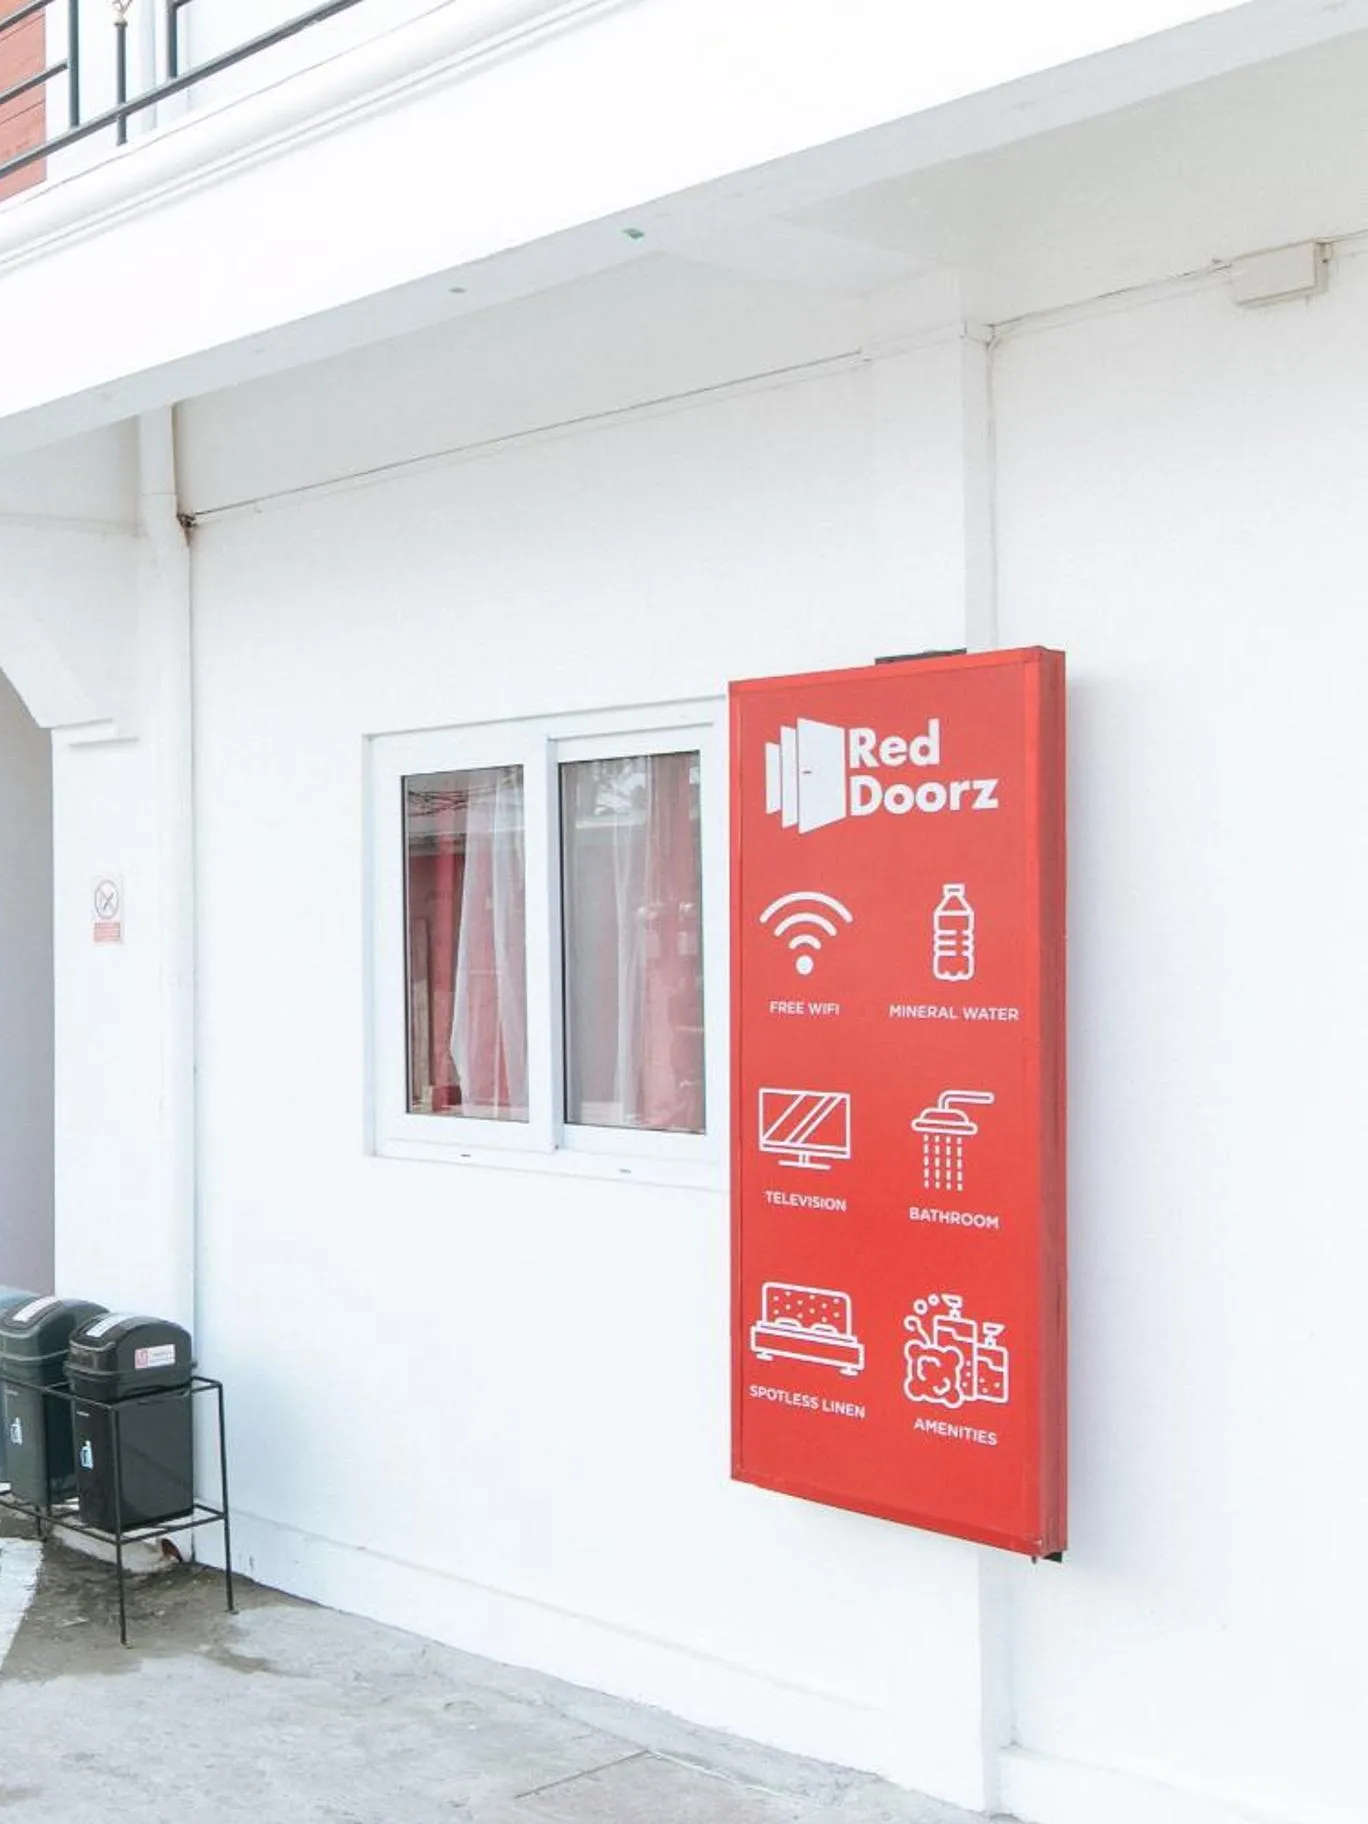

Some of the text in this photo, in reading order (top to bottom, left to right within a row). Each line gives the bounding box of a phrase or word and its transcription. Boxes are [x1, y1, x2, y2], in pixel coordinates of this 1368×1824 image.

[848, 718, 941, 770] Red
[849, 774, 1000, 817] Doorz
[769, 1000, 840, 1017] FREE WIFI
[889, 1004, 1019, 1022] MINERAL WATER
[764, 1190, 848, 1213] TELEVISION
[908, 1206, 1000, 1229] BATHROOM
[749, 1384, 866, 1419] SPOTLESS LINEN
[913, 1417, 998, 1446] AMENITIES
